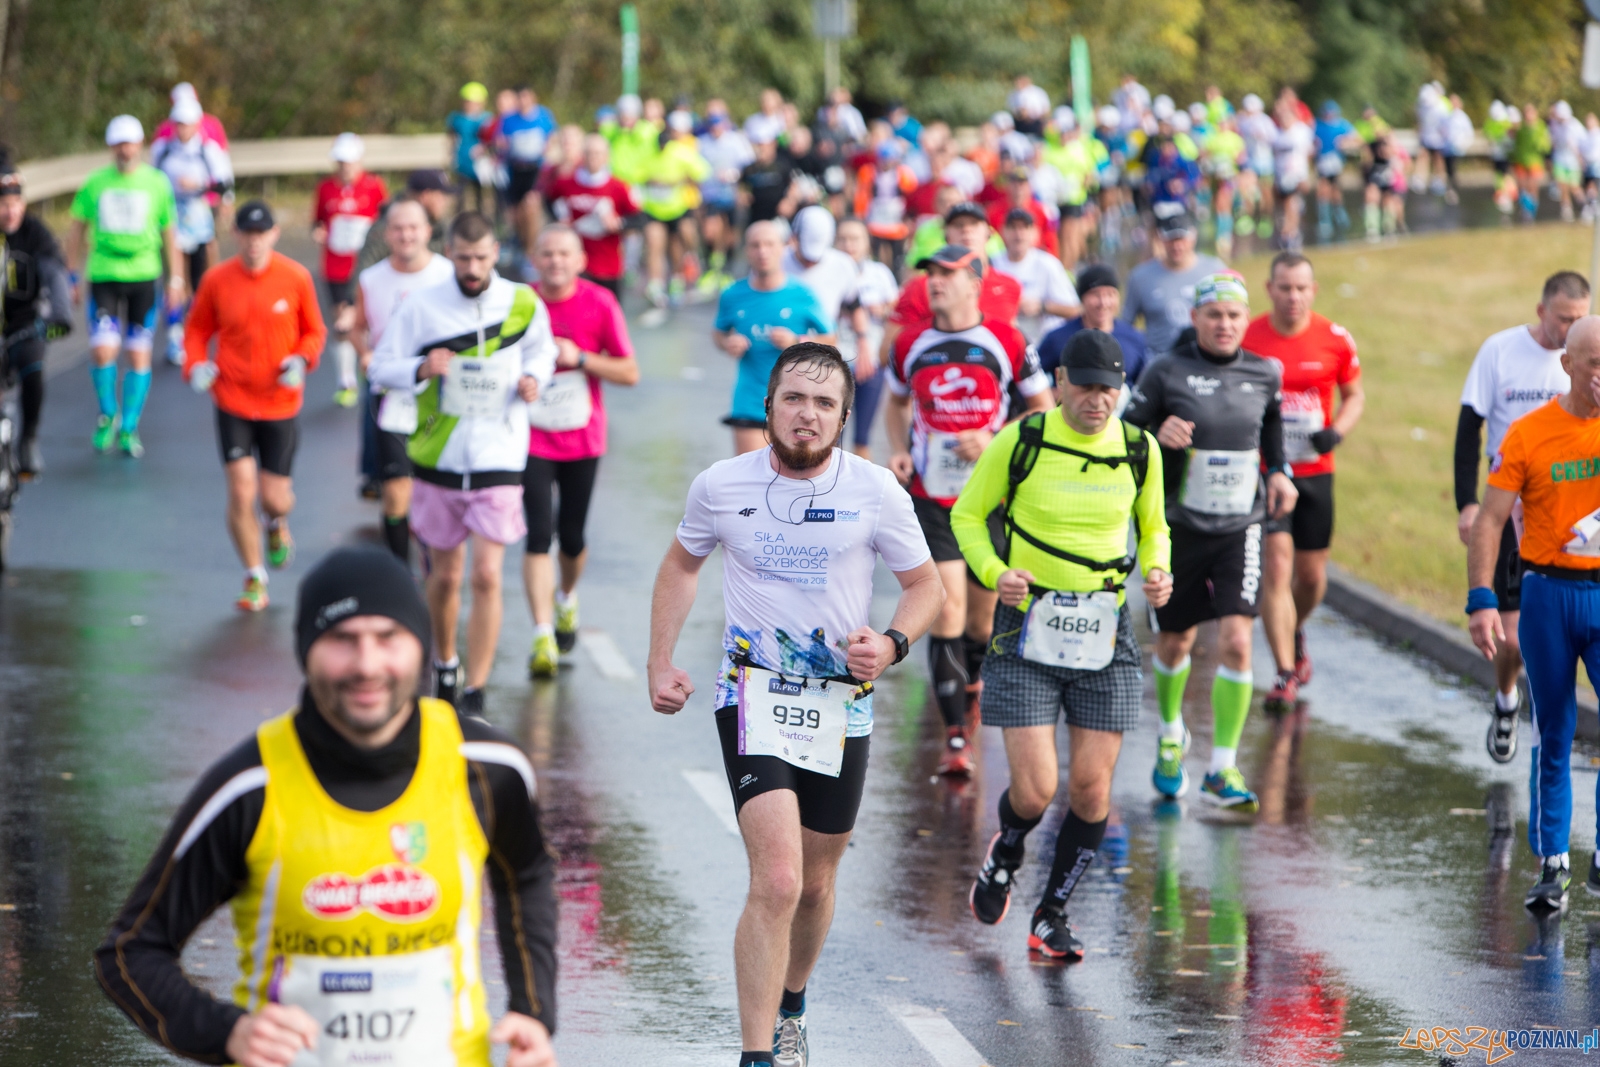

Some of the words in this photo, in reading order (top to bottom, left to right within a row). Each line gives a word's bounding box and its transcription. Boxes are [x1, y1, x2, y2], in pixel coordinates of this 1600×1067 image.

[738, 507, 758, 517] 4F
[754, 531, 785, 543] SIŁA
[763, 544, 829, 557] ODWAGA
[753, 556, 828, 569] SZYBKOŚĆ
[810, 577, 828, 585] 2016
[1046, 615, 1101, 634] 4684
[772, 704, 821, 729] 939
[778, 728, 814, 742] Bartosz
[324, 1008, 415, 1042] 4107
